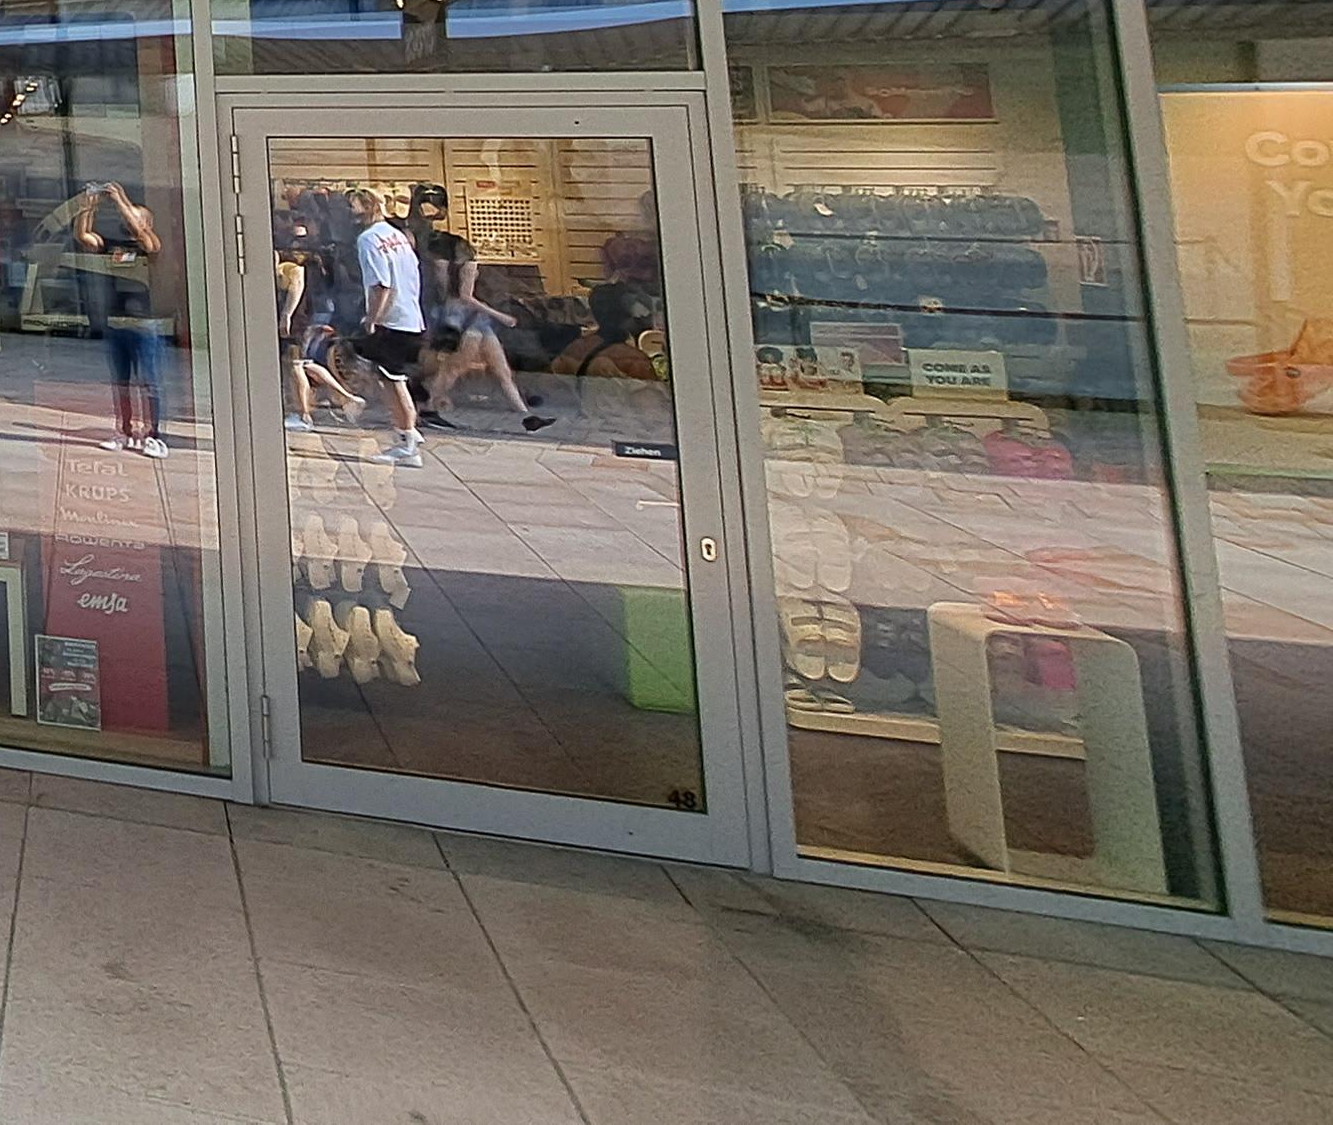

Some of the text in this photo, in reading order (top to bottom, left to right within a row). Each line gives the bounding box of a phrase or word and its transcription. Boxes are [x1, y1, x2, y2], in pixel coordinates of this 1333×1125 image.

[1244, 130, 1333, 167] Co
[922, 361, 991, 374] COME AS
[925, 374, 991, 386] YOU ARE
[65, 458, 129, 477] Tefal
[65, 483, 132, 502] KRUPS
